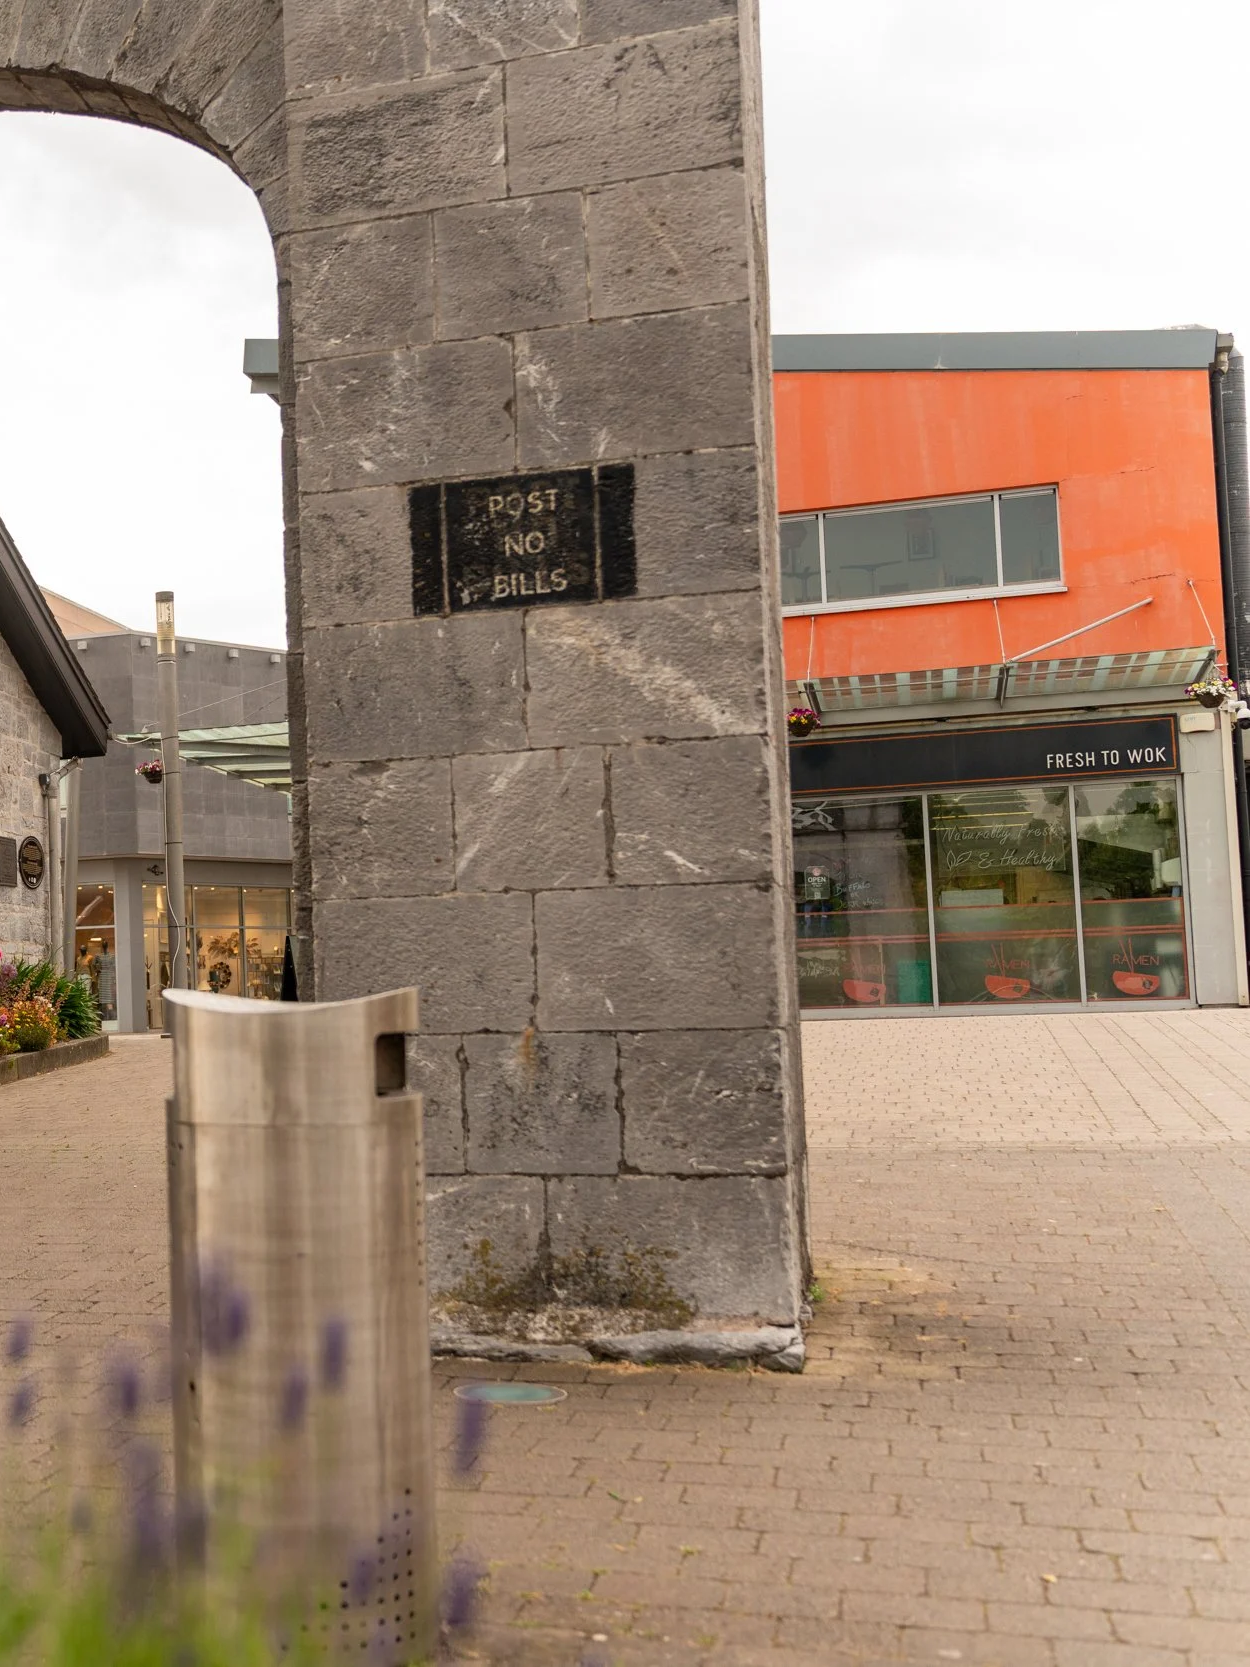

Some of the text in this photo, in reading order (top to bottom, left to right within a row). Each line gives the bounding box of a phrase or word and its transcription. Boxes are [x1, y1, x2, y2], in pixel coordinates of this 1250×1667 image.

[488, 489, 559, 518] POST
[503, 532, 546, 557] NO
[493, 568, 569, 598] BILLS
[1046, 746, 1167, 769] FRESH TO WOK
[942, 824, 1011, 845] Naturally
[977, 849, 1057, 871] & Healthy
[1112, 953, 1160, 966] RAMEN
